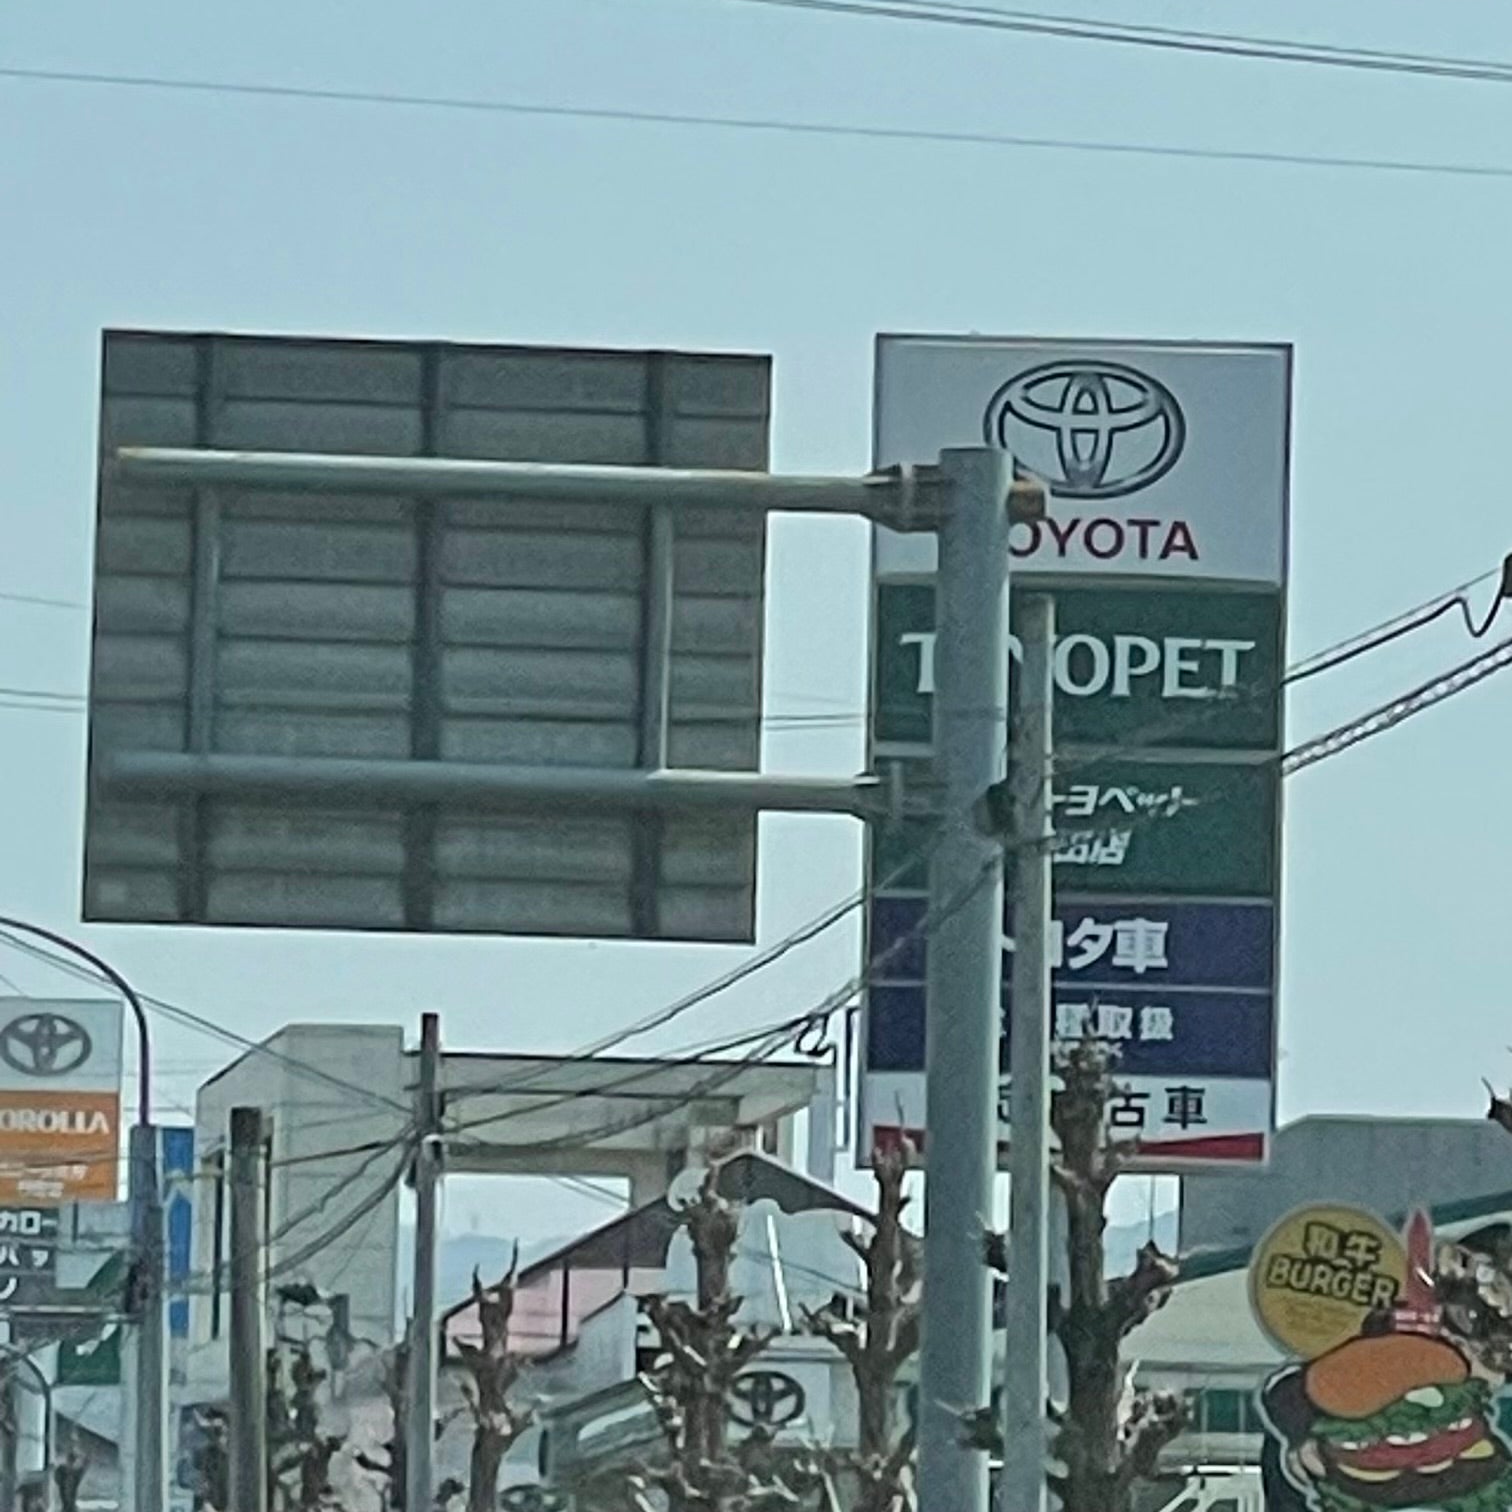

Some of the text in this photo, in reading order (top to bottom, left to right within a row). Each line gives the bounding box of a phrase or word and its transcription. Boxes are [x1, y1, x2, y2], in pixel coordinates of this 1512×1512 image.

[1006, 516, 1200, 560] OYOTA
[900, 630, 1256, 699] TOPET
[0, 1109, 110, 1134] OROLLA
[1268, 1256, 1397, 1308] BURGER
